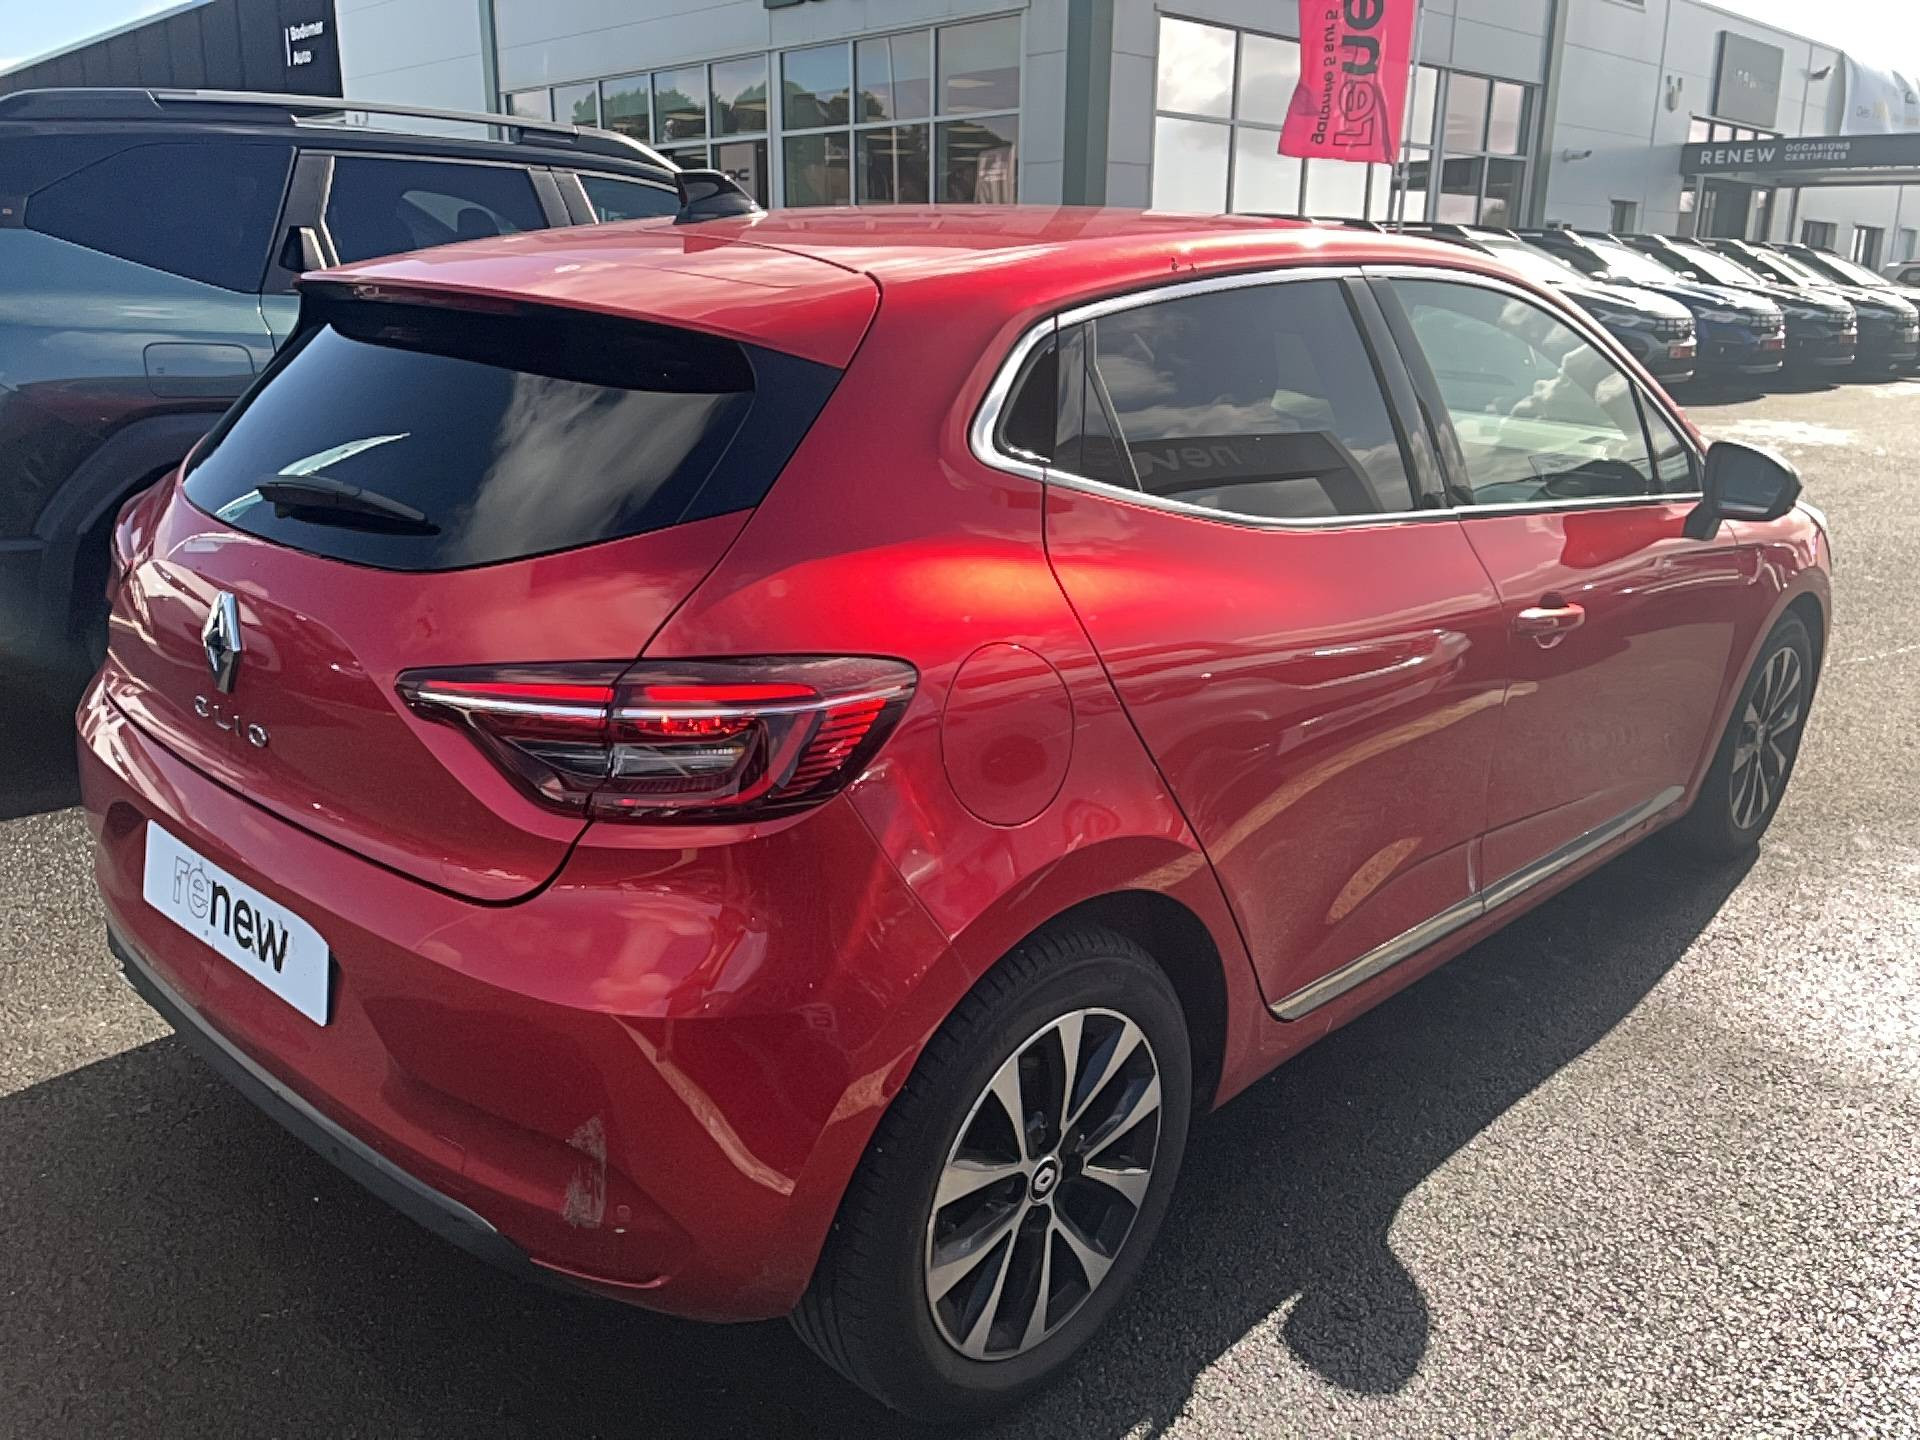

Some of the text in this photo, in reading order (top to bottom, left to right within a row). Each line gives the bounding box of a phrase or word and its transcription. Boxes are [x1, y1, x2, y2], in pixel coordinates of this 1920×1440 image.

[293, 50, 311, 65] Auto
[1785, 142, 1851, 152] OCCASIONS
[1700, 148, 1776, 165] RENEW
[195, 695, 268, 748] CLIO
